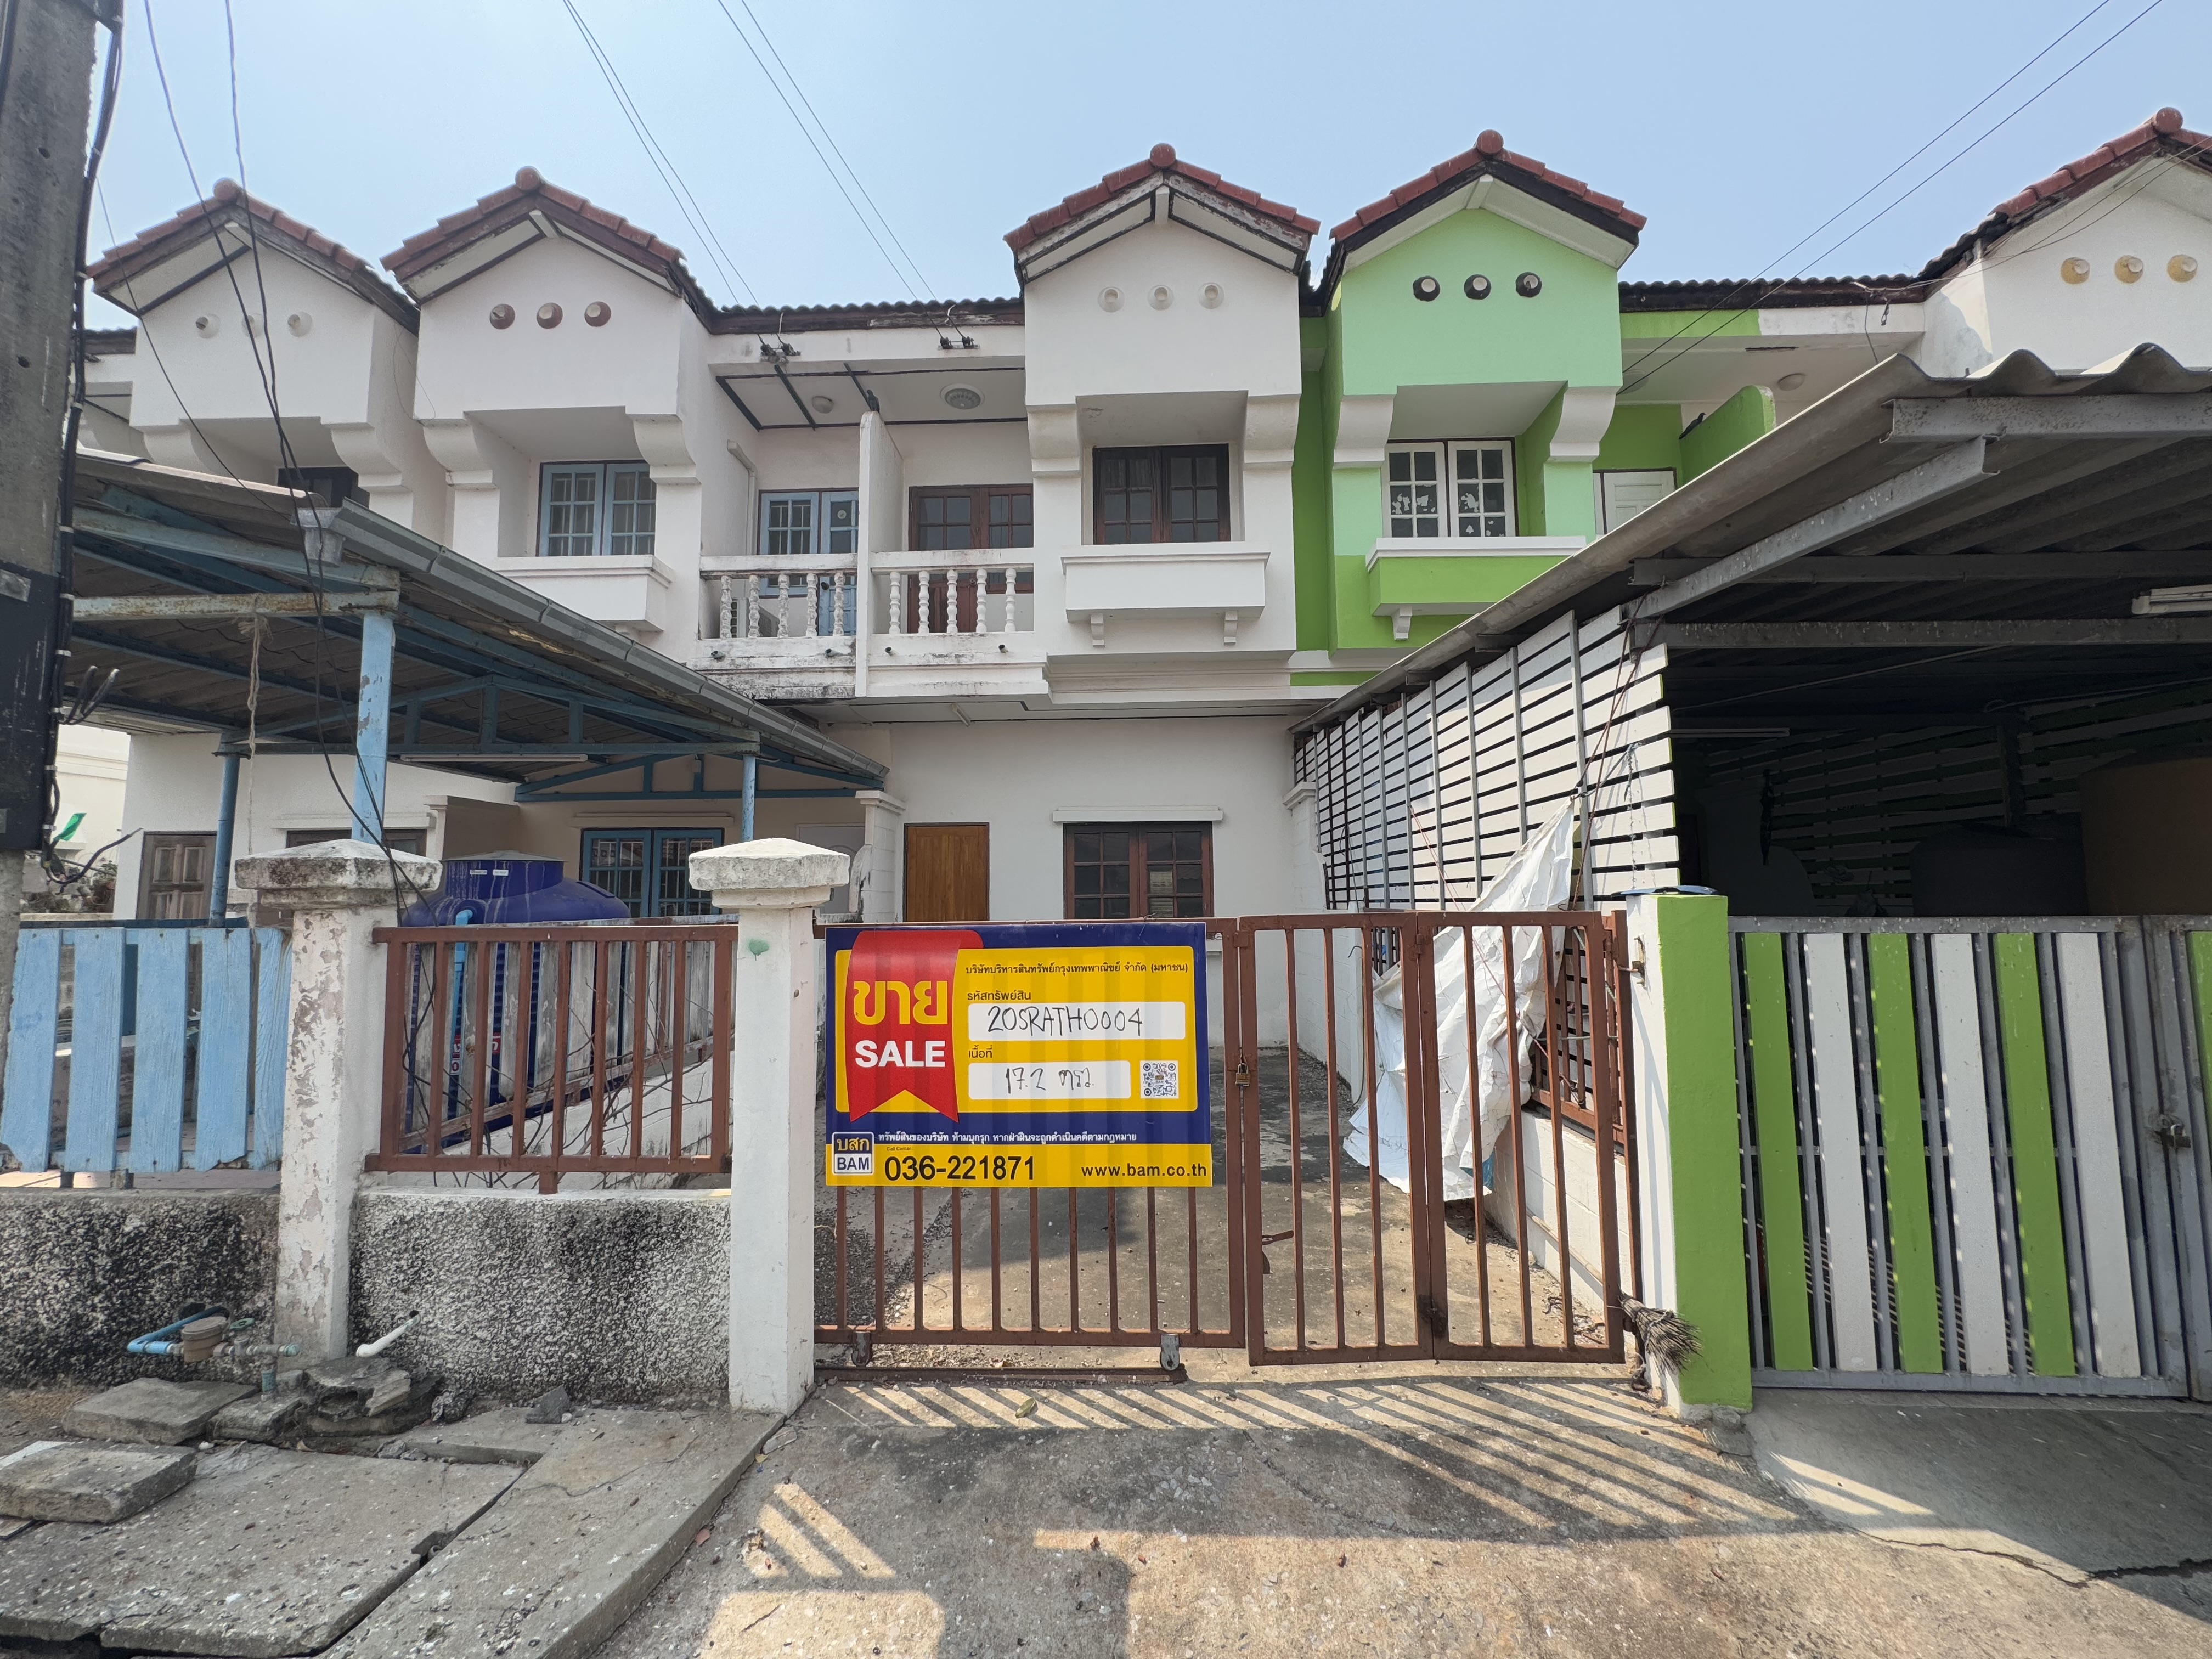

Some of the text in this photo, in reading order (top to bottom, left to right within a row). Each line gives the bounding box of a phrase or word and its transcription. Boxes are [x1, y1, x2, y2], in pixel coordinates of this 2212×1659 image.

[966, 961, 1188, 976] บริษัทบริหารสินทรัพย์กรุงเทพพาณิชย์ จำกัด (มหาชน)
[854, 981, 948, 1025] ขาย
[967, 990, 1031, 1001] รหัสทรัพย์สิน
[855, 1040, 946, 1068] SALE
[968, 1045, 992, 1058] เนื้อที่
[1005, 1067, 1047, 1094] 17.2
[837, 1137, 870, 1152] บสก
[878, 1131, 1137, 1144] ทรัพย์สินของบริษัท ห้ามบุกรุก หากฝ่าฝืนจะถูกดำเนินคดีตามกฎหมาย
[837, 1156, 870, 1170] BAM
[885, 1155, 1034, 1181] 036-221871
[1081, 1163, 1207, 1177] www.bam.co.th
